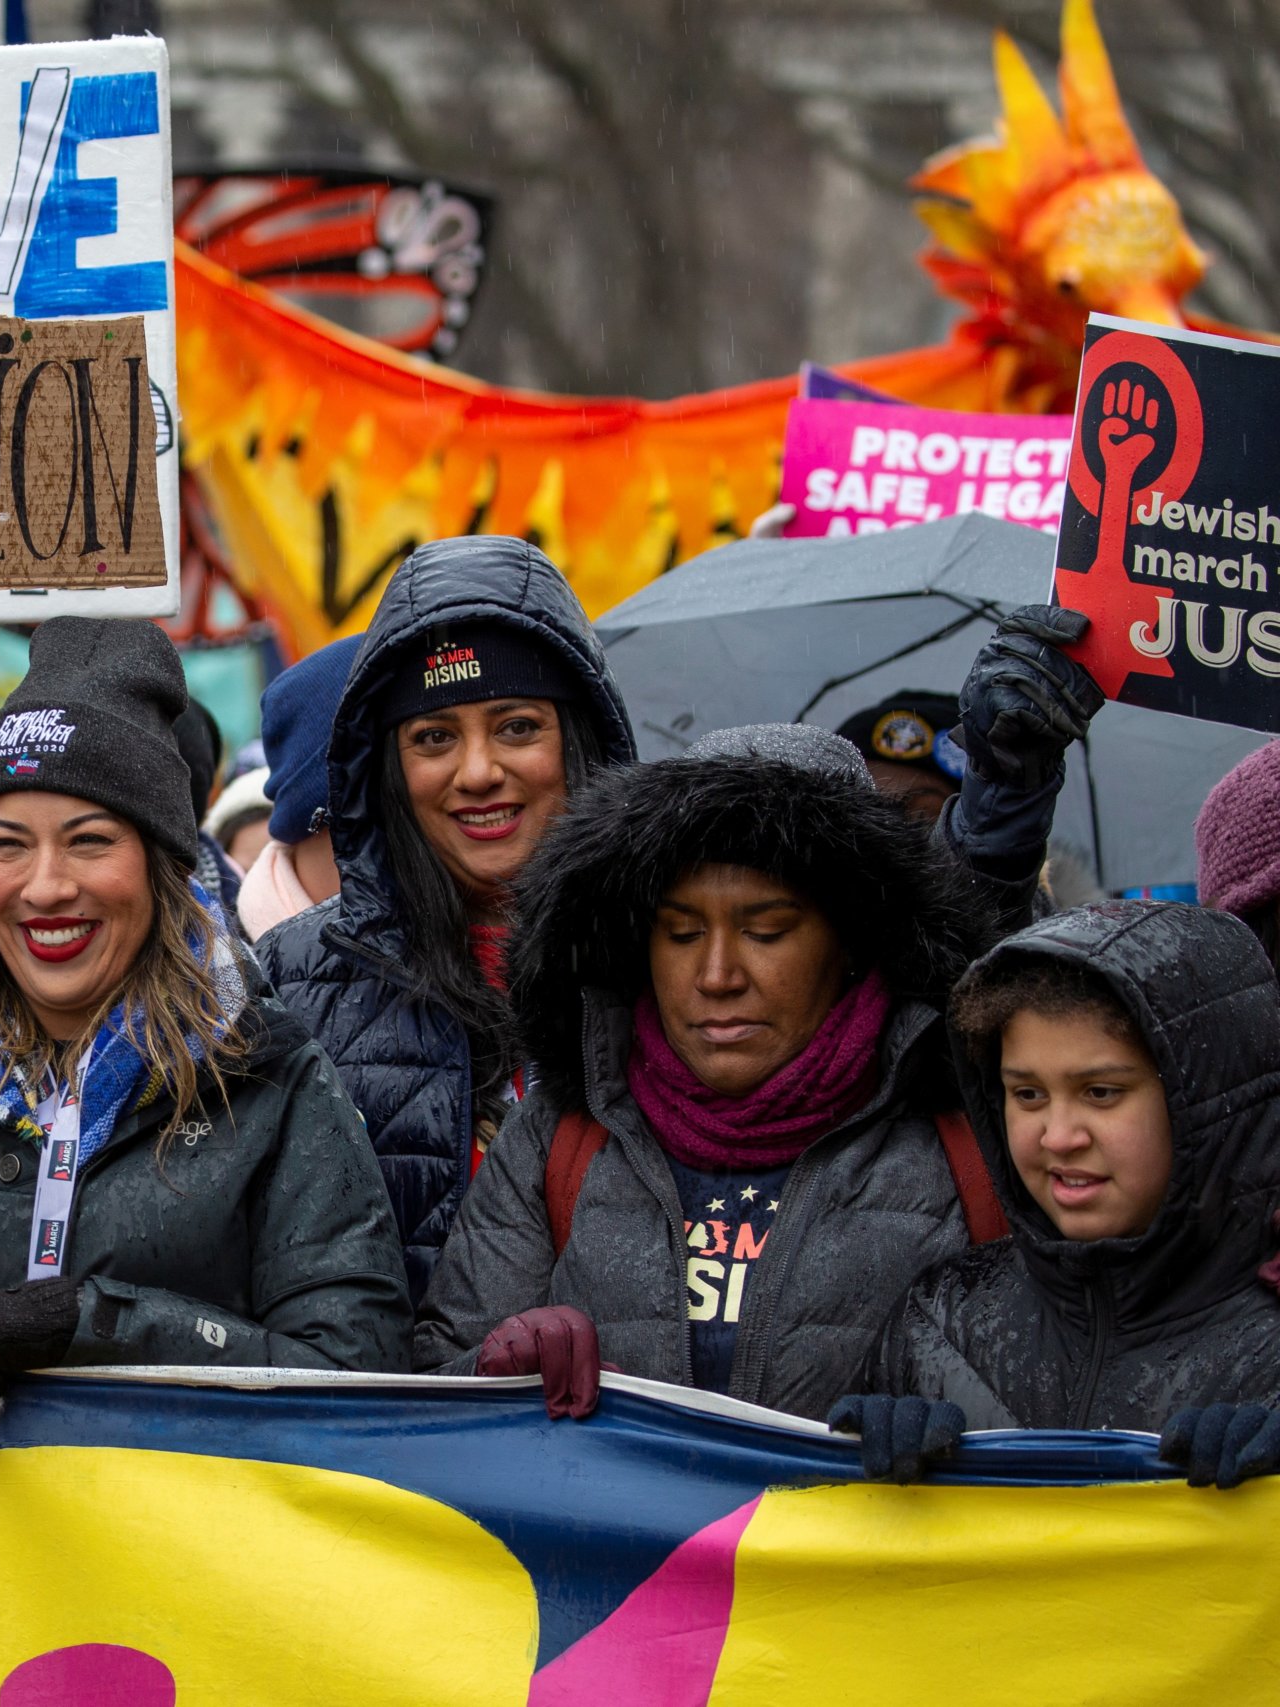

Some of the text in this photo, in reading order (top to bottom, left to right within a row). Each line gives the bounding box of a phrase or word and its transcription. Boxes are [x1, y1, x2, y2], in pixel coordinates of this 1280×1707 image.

[850, 426, 1071, 477] PROTECT
[804, 467, 942, 521] SAFE,
[1137, 491, 1280, 544] Jewish
[1133, 544, 1267, 592] march
[1129, 596, 1280, 677] JUS
[427, 648, 474, 668] WOMEN
[424, 661, 481, 689] RISING
[0, 709, 66, 730] EMBRACE
[21, 725, 76, 744] POWER
[35, 744, 65, 753] 2020
[62, 1141, 73, 1164] MARCH
[49, 1222, 59, 1247] MARCH
